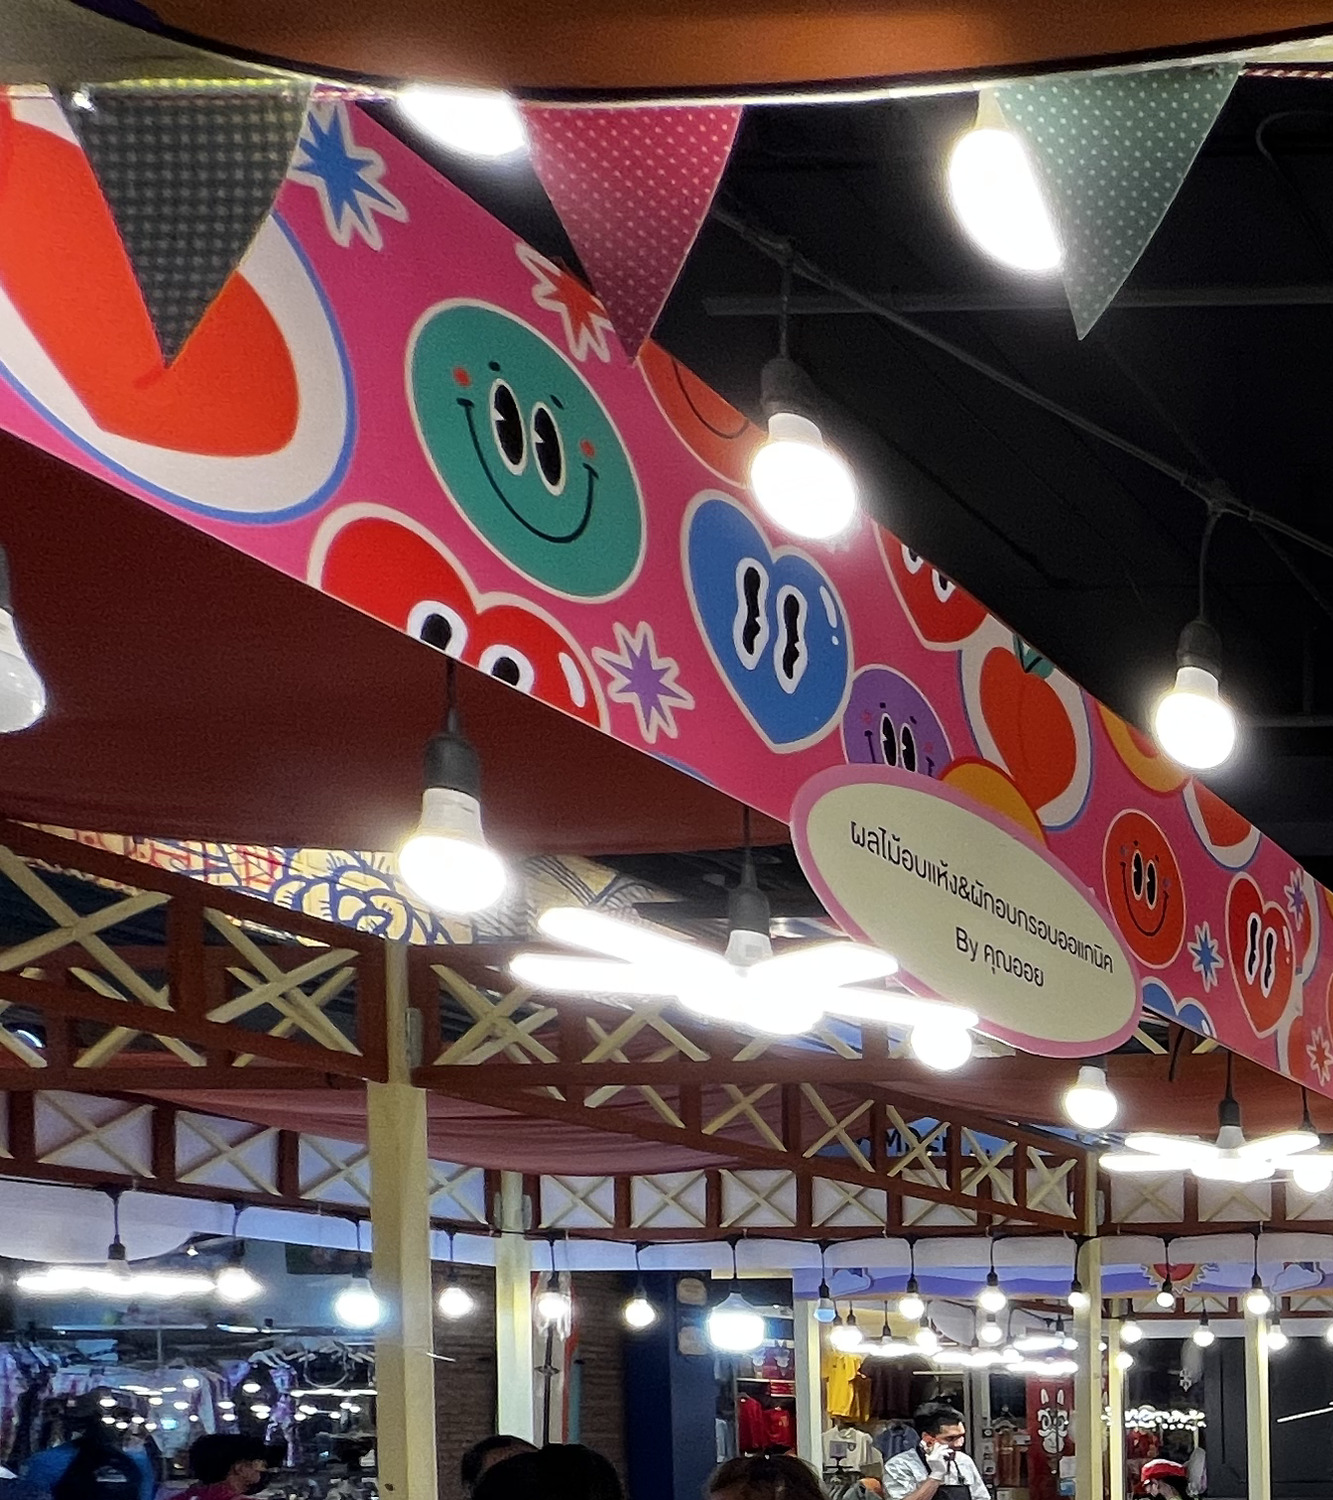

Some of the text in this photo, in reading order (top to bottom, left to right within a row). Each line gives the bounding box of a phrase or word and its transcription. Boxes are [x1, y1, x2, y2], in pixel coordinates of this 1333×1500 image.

[955, 926, 1045, 988] By คุณออย
